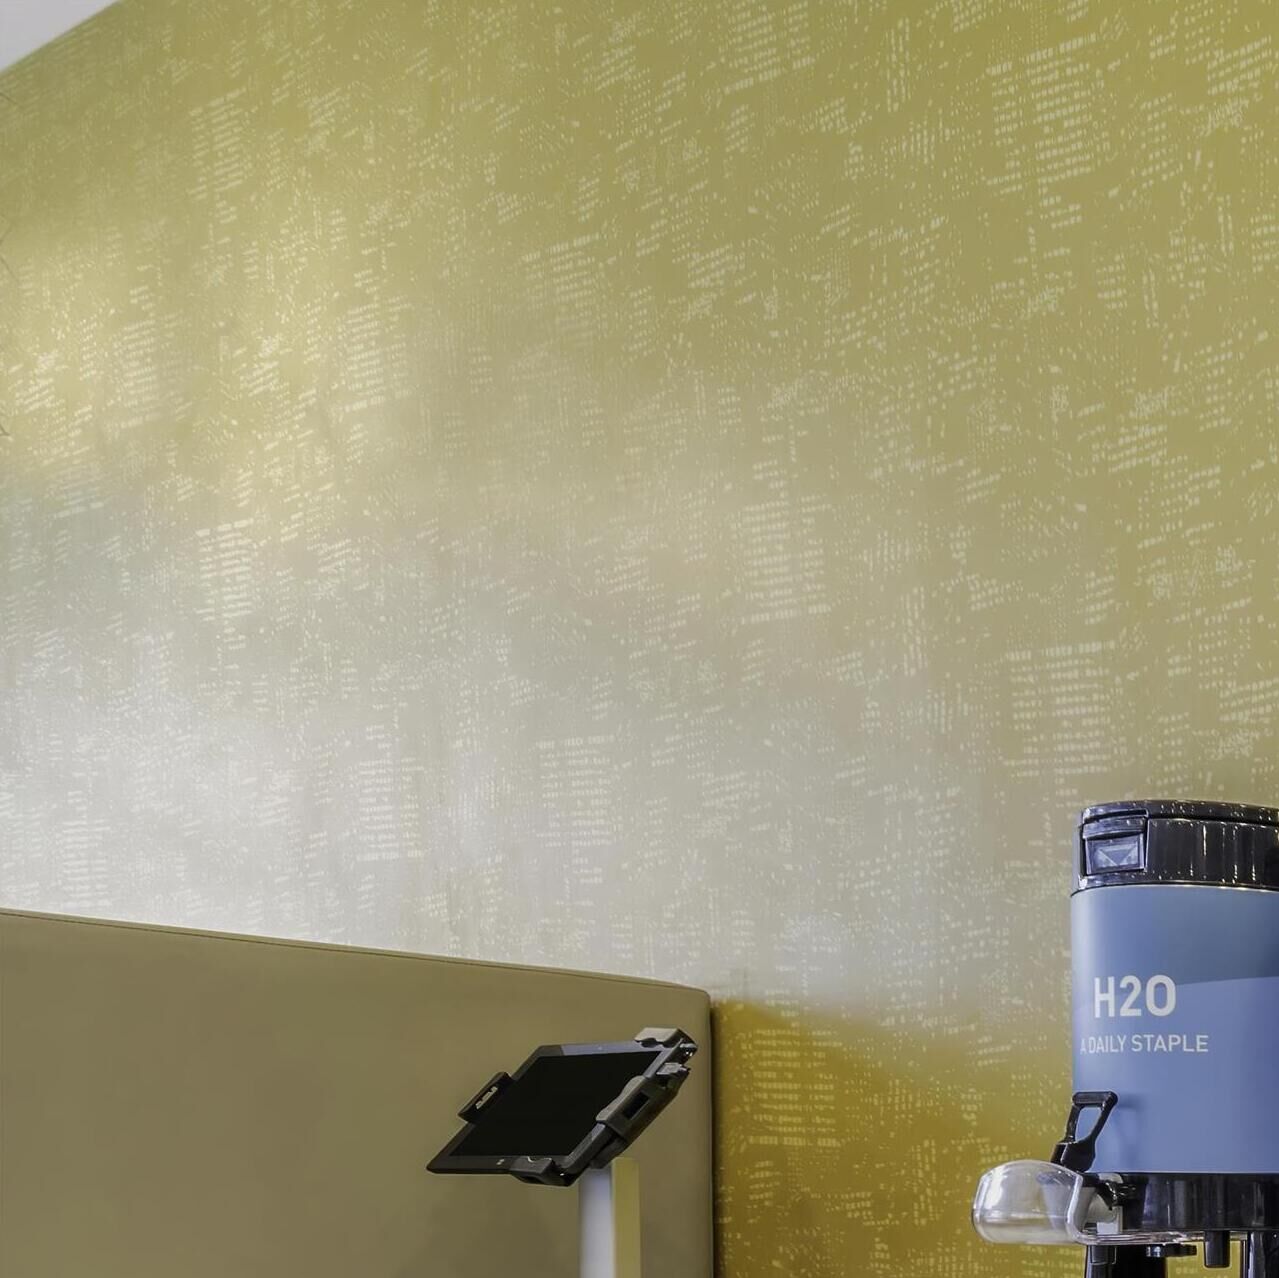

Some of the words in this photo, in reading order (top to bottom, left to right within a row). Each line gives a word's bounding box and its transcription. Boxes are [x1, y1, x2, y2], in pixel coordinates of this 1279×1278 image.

[1094, 974, 1176, 1018] H2O
[1080, 1039, 1087, 1055] A
[1088, 1034, 1127, 1055] DAILY
[1131, 1034, 1209, 1053] STAPLE
